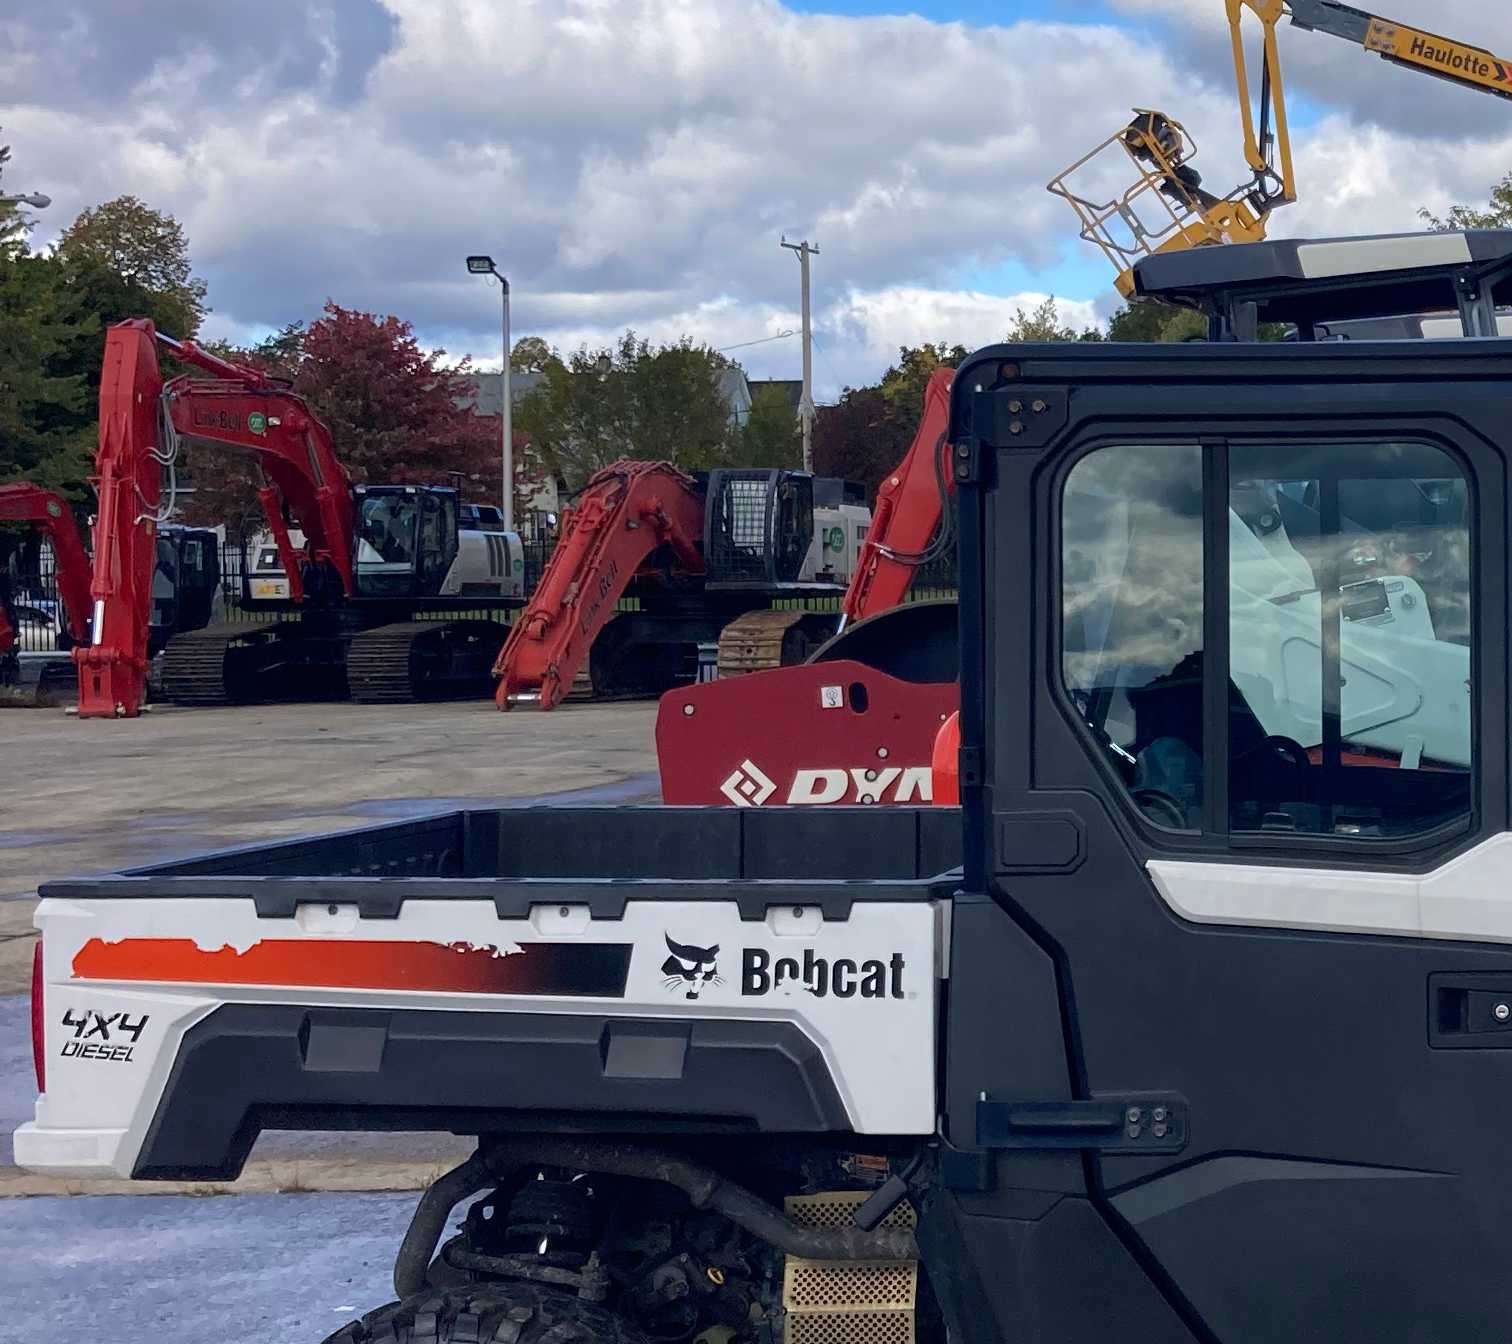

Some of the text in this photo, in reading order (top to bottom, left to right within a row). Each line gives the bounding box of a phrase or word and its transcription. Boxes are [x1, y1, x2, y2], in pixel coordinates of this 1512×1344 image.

[1410, 36, 1489, 77] Haulotte
[741, 948, 905, 999] Bobcat
[61, 1042, 133, 1062] DIESEL
